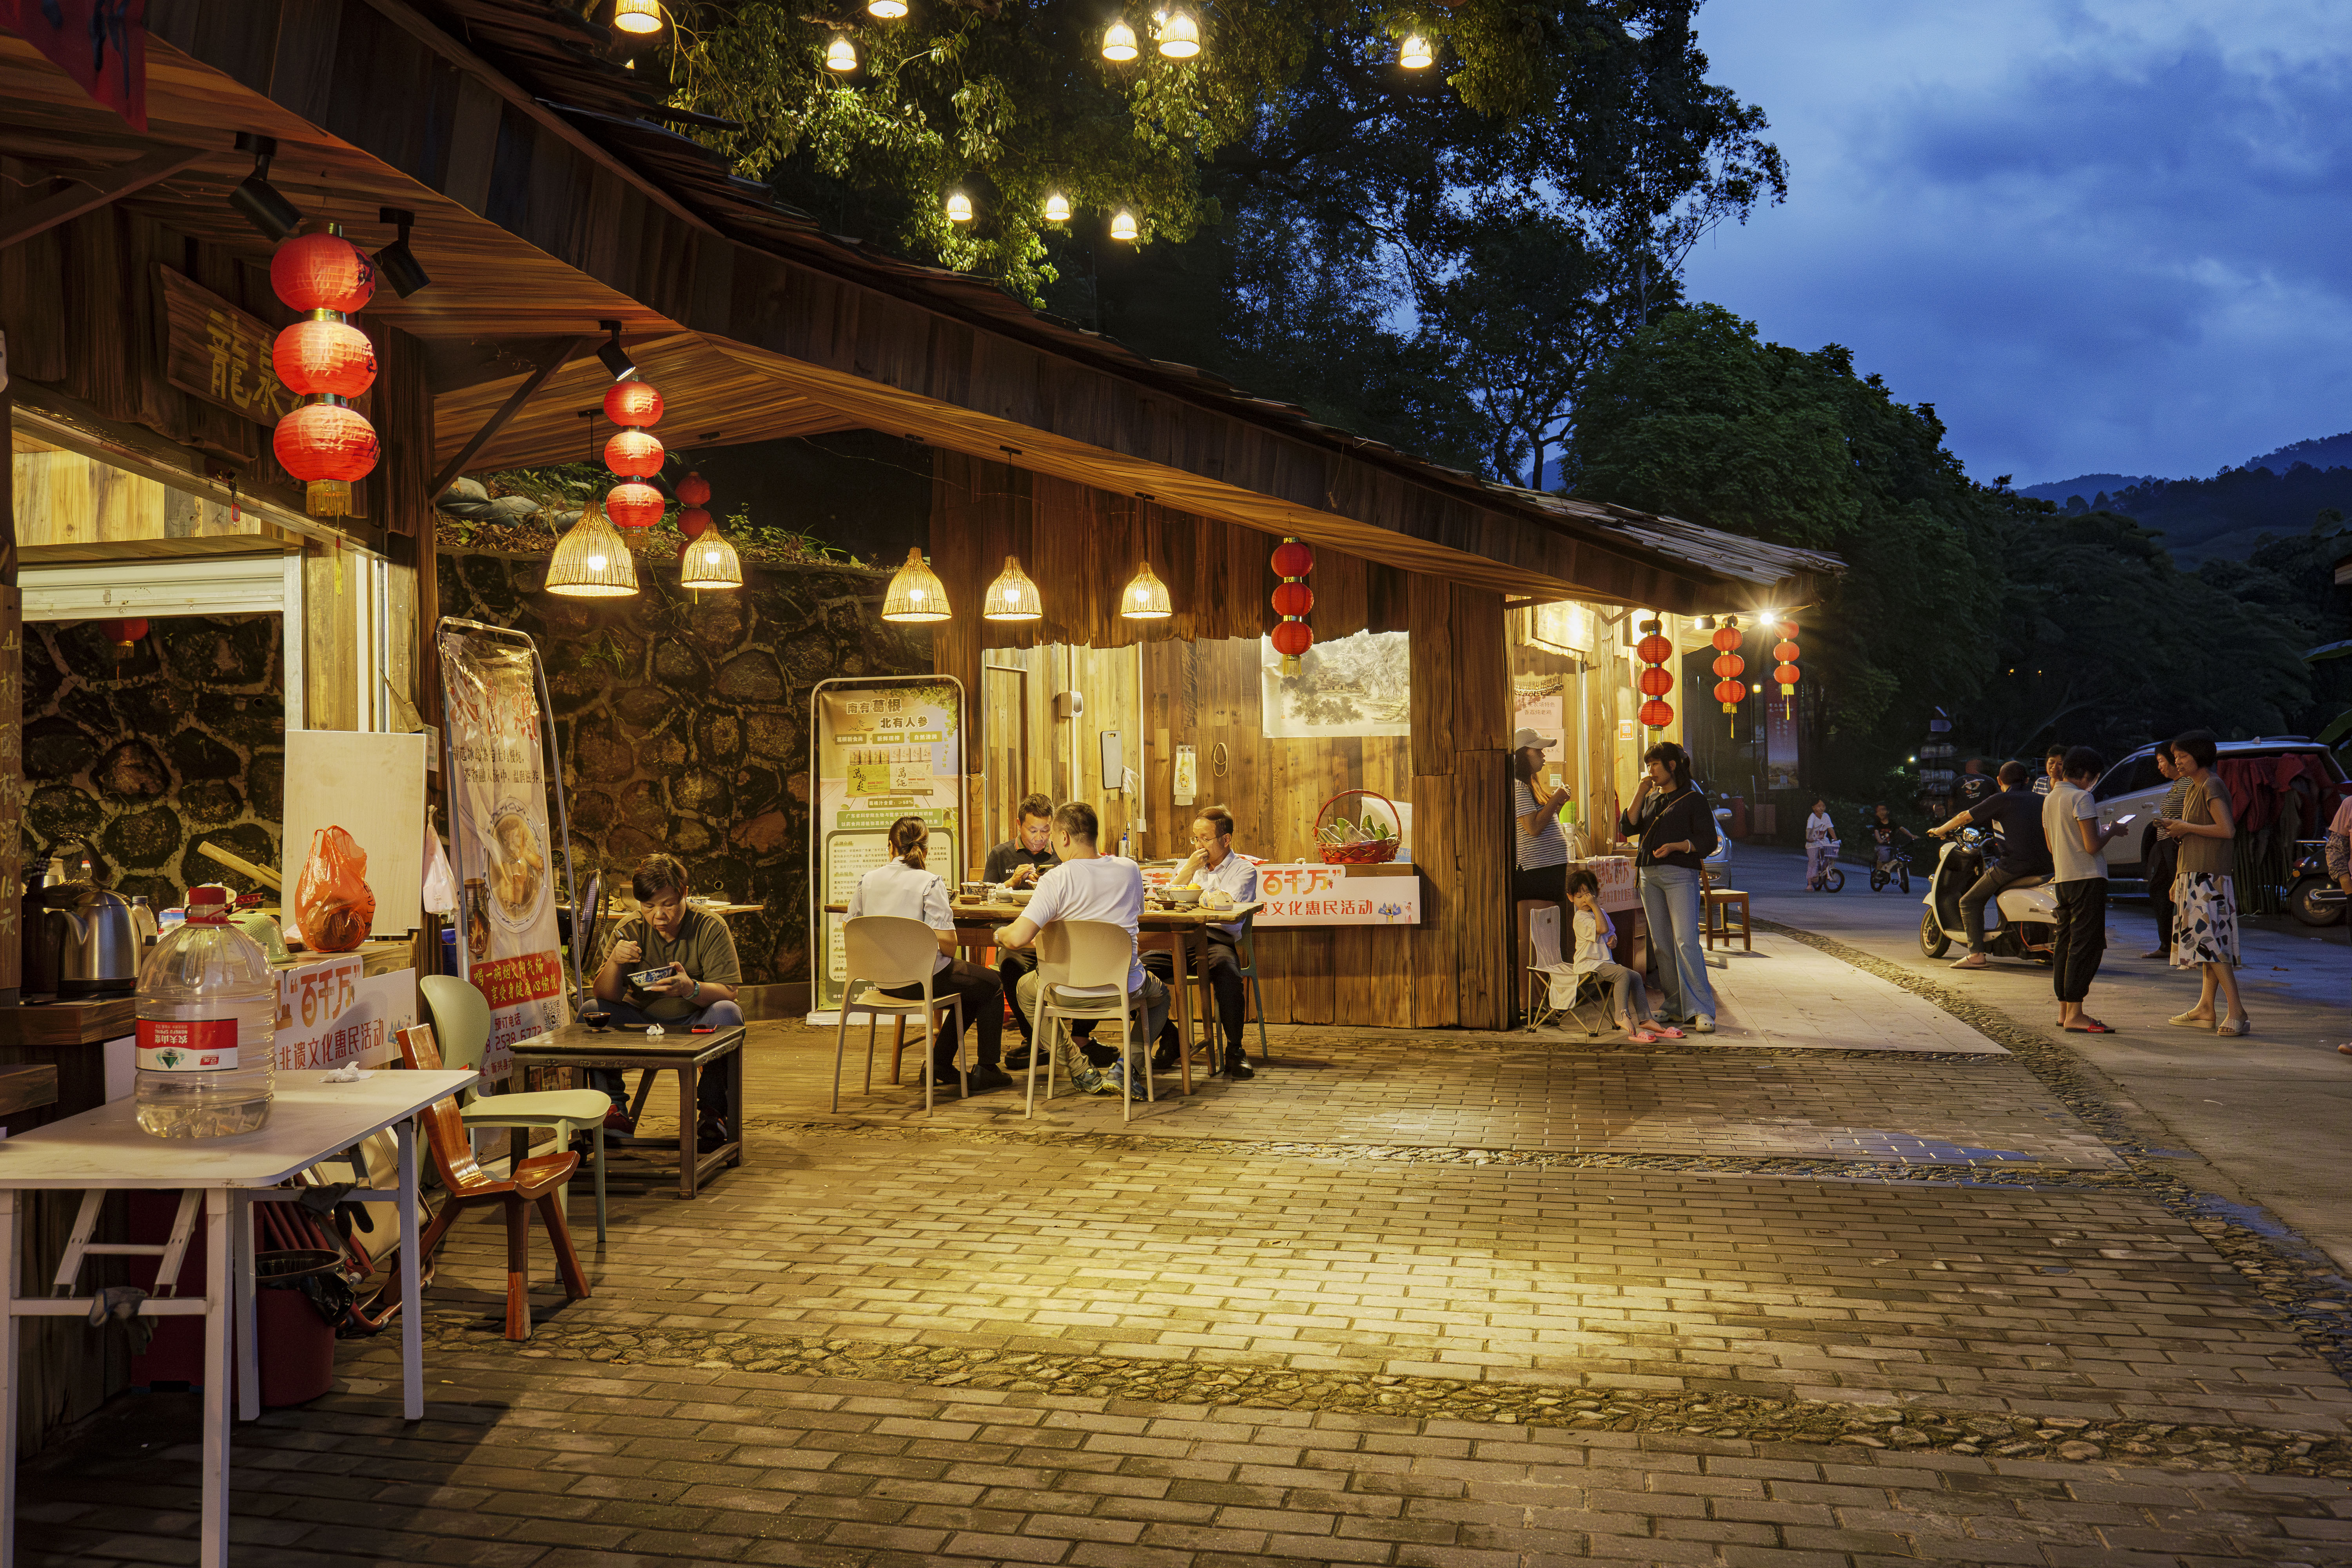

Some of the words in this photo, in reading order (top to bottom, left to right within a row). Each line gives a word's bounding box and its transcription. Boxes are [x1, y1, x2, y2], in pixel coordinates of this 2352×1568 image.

[847, 698, 902, 714] 南有葛根
[880, 716, 928, 729] 北有人参
[491, 973, 558, 1004] 享受身健康心愉悦
[494, 1013, 521, 1031] 预订电话
[155, 1034, 188, 1044] 农夫山泉
[275, 1018, 384, 1070] 非遗文化惠民活动
